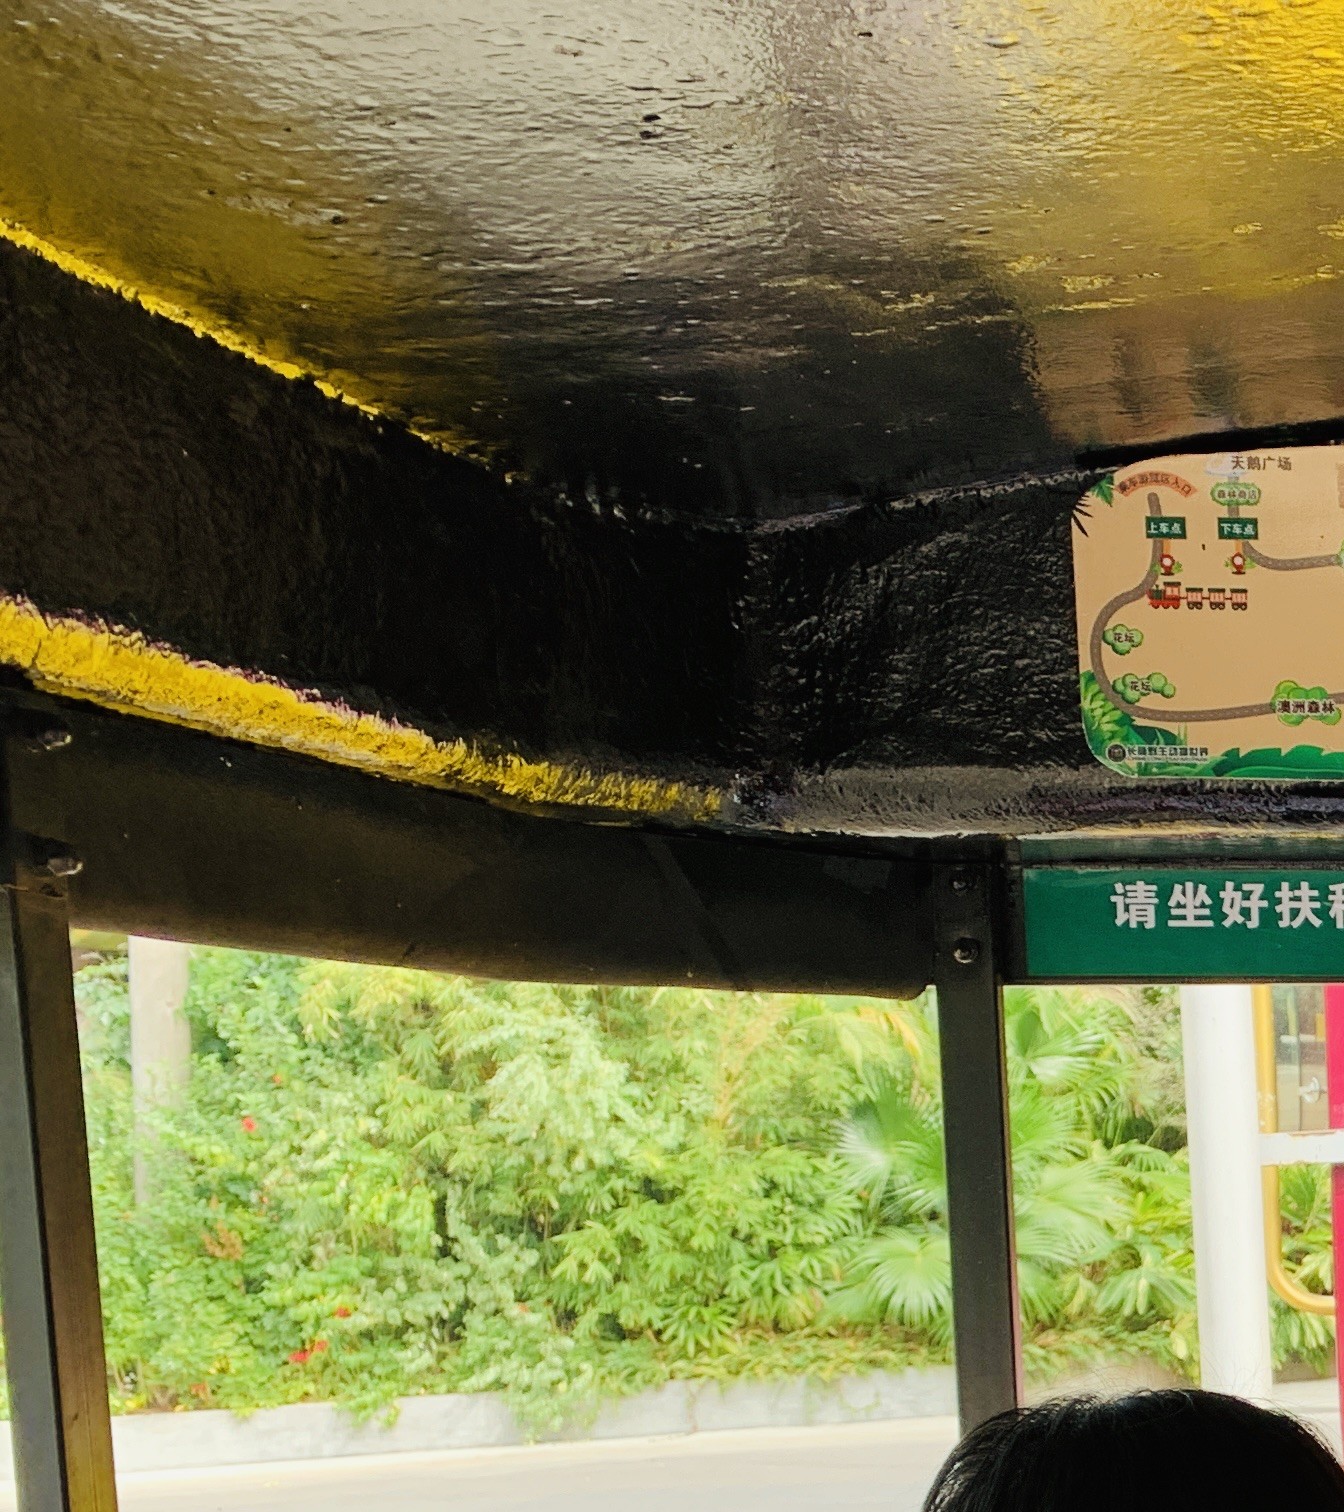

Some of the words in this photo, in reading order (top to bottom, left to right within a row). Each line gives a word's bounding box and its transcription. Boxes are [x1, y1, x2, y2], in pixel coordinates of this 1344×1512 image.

[1231, 455, 1293, 471] 天鹅广场
[1147, 521, 1183, 535] 上车点
[1221, 522, 1256, 536] 下车点
[1114, 632, 1135, 643] 花坛
[1130, 681, 1152, 692] 花坛
[1277, 700, 1335, 715] 澳洲森林
